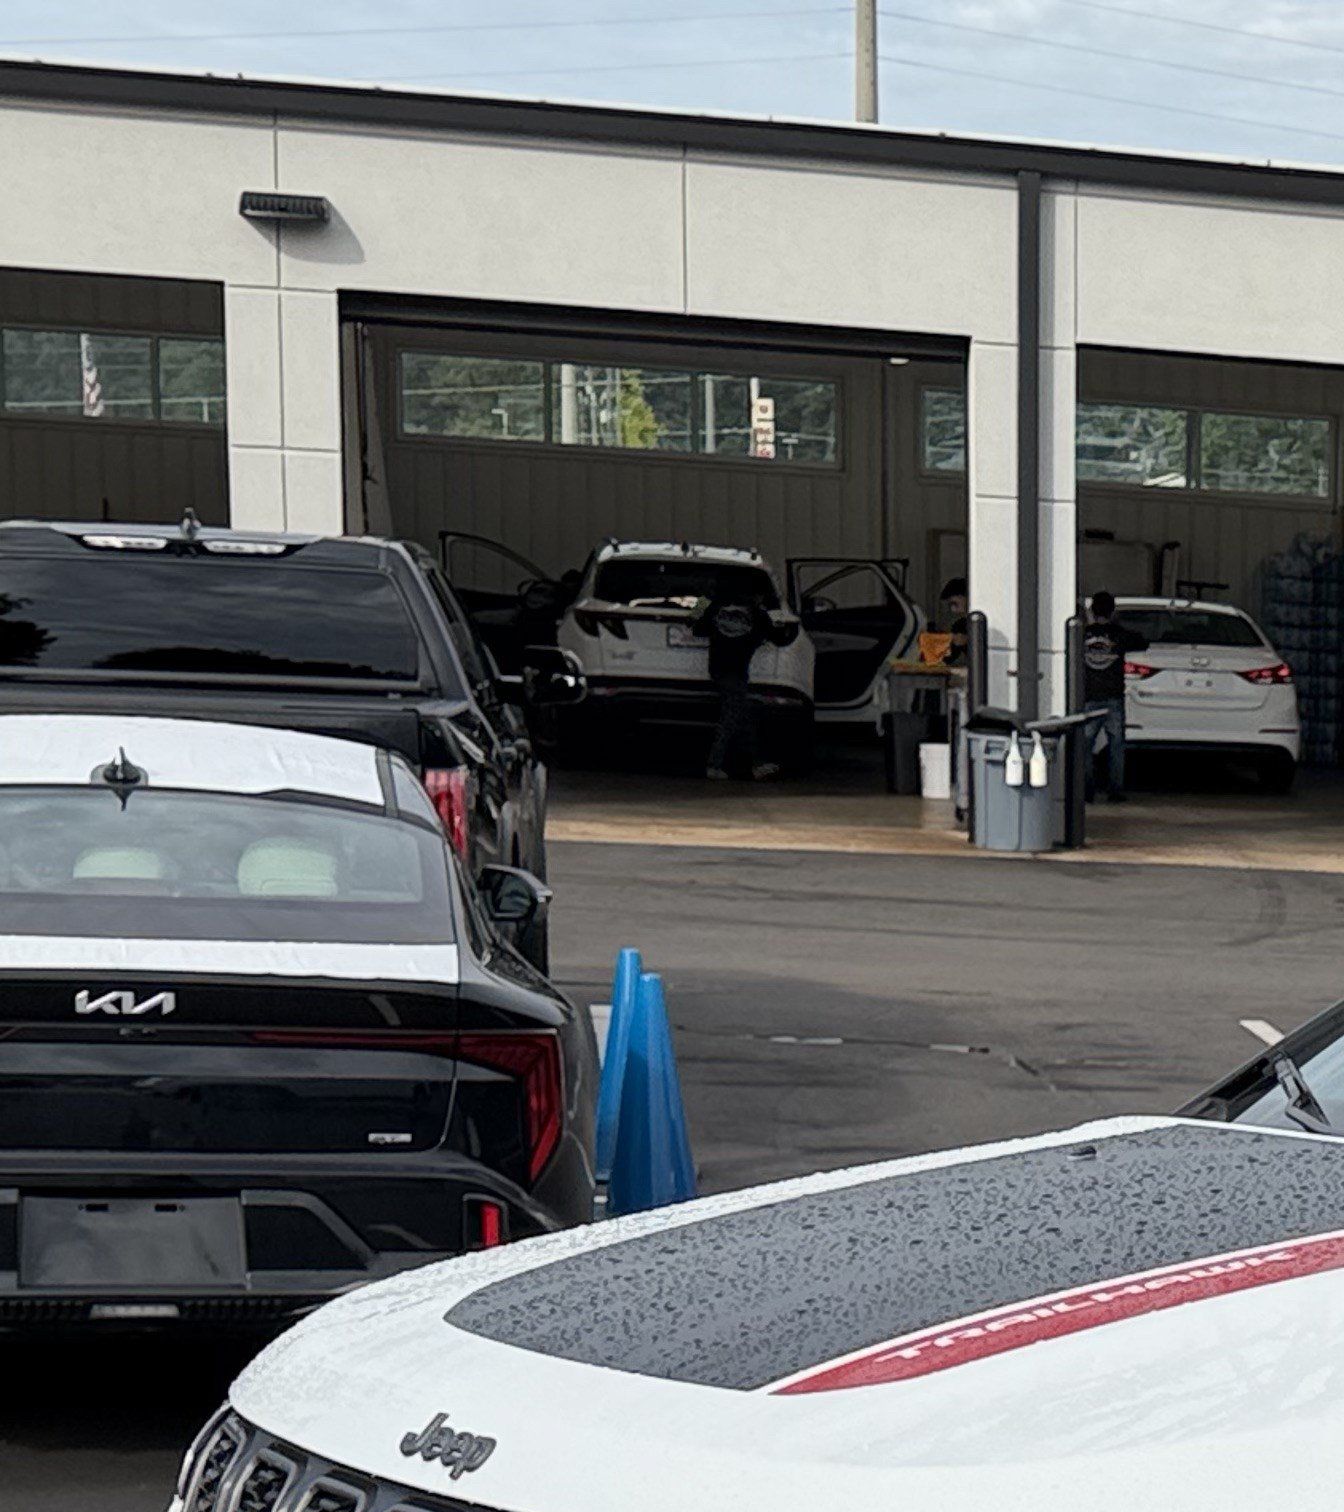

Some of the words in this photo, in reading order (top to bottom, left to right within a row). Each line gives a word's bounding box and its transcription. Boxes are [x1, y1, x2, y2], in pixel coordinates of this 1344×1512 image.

[75, 989, 176, 1015] KIA
[874, 1251, 1297, 1363] TRAILHAWK
[399, 1412, 497, 1480] Jeep
